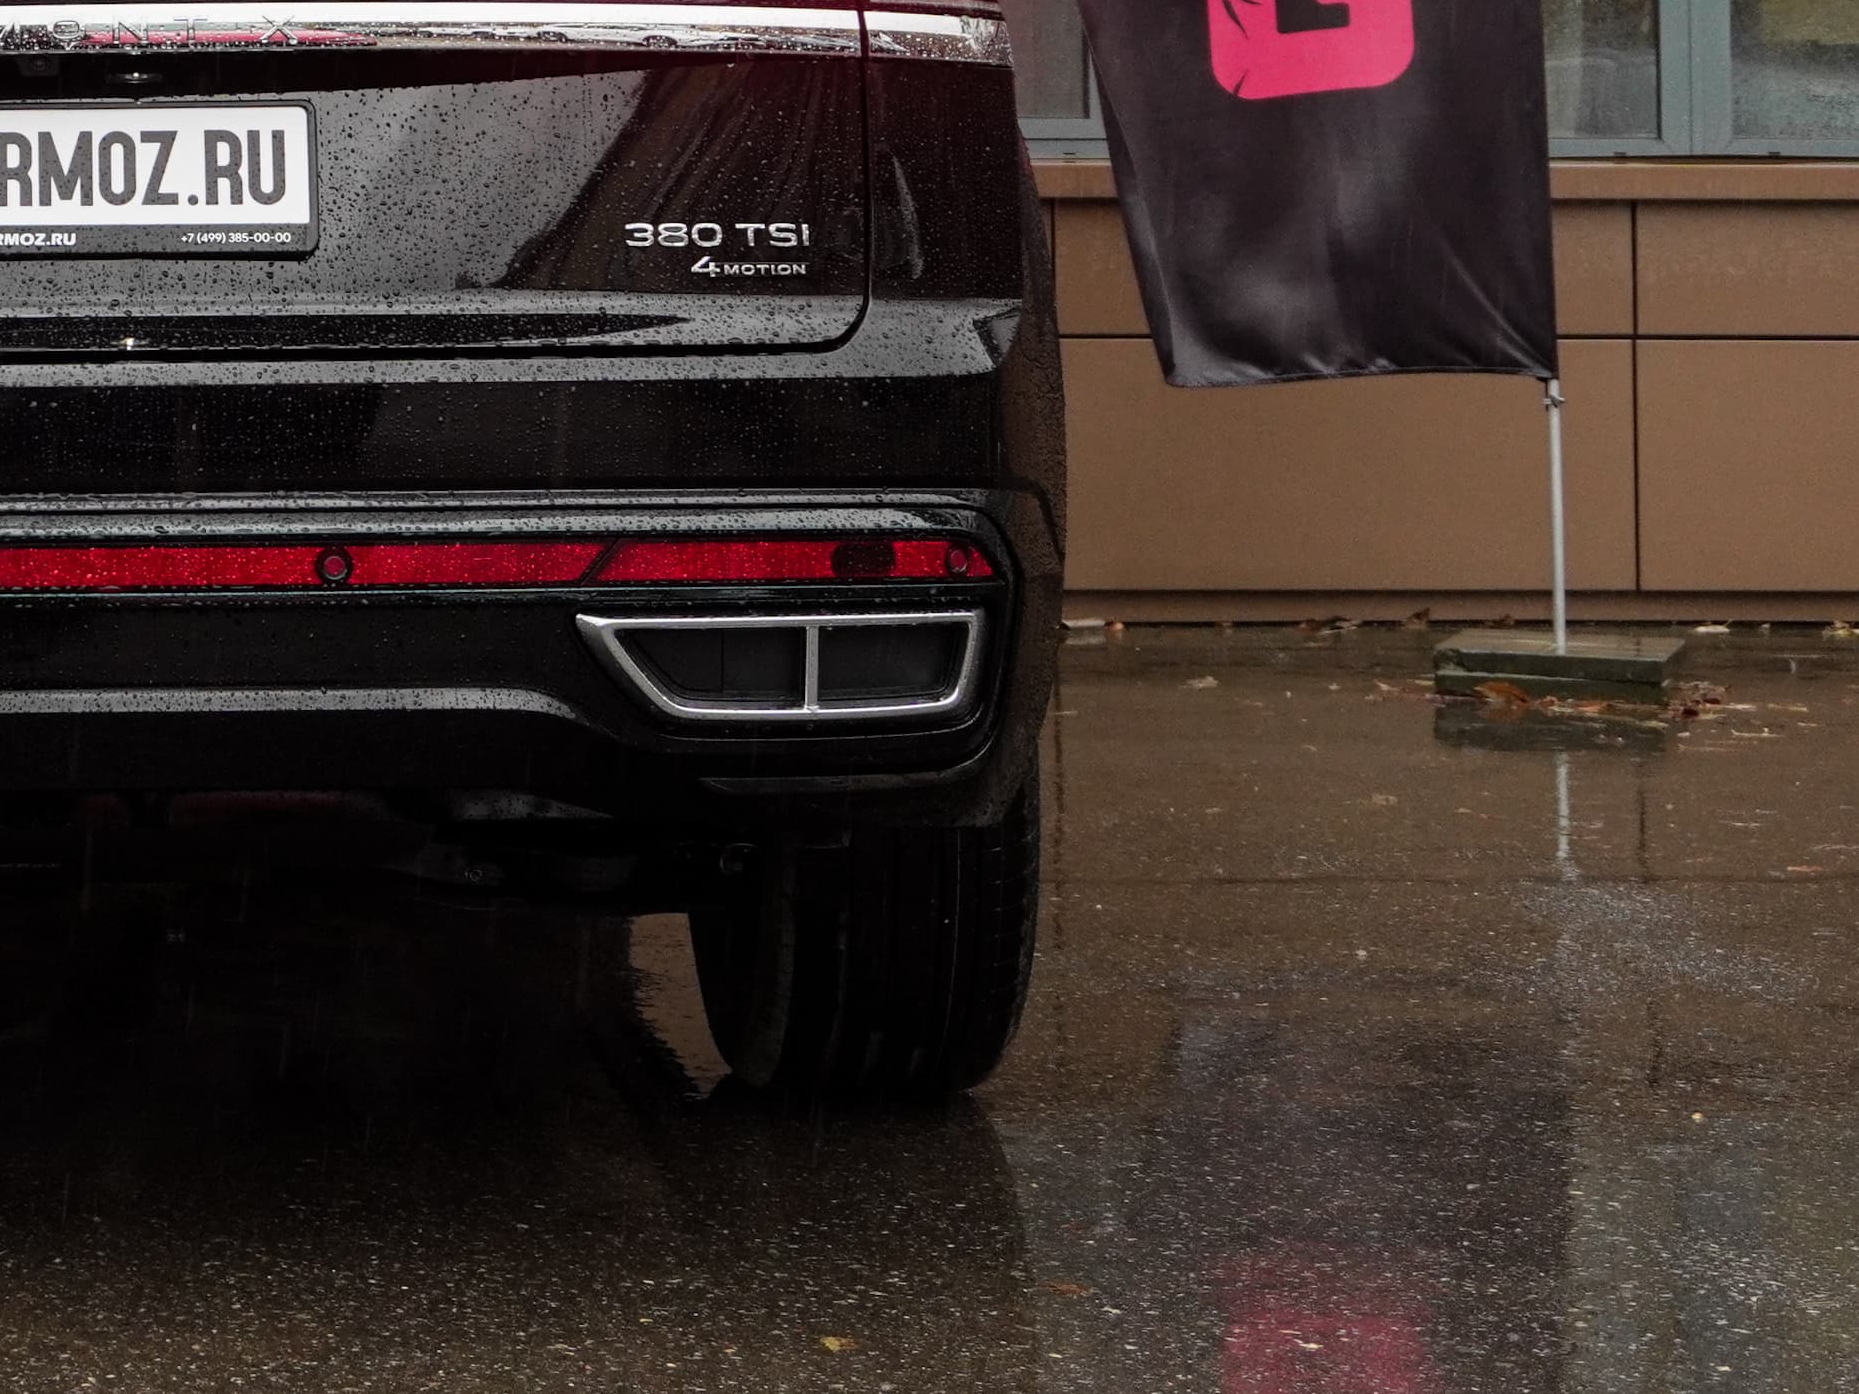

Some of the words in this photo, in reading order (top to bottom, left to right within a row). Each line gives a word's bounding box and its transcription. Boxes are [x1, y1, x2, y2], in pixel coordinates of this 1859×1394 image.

[260, 14, 298, 44] X
[180, 232, 195, 243] +7
[196, 231, 227, 245] (499)
[227, 231, 292, 244] 385-00-00
[624, 222, 724, 248] 380
[734, 222, 811, 247] TSI
